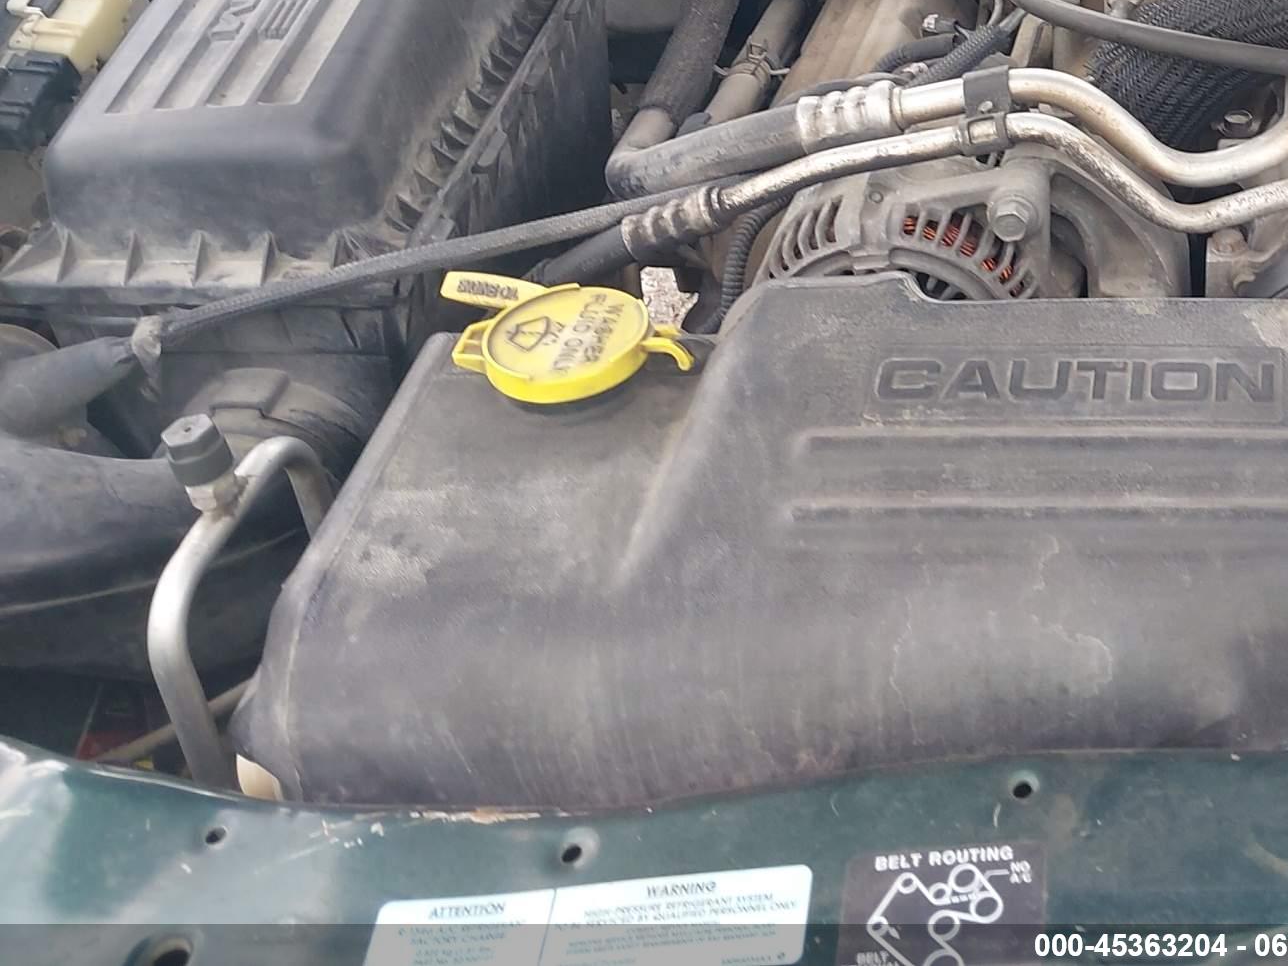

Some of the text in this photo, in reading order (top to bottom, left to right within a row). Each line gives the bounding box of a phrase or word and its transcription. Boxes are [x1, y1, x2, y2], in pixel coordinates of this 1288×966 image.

[874, 358, 1276, 404] CAUTION
[875, 845, 1014, 872] BELT ROUTING
[1009, 860, 1031, 873] NO
[645, 880, 717, 899] WARNING
[427, 901, 507, 921] ATTENTION
